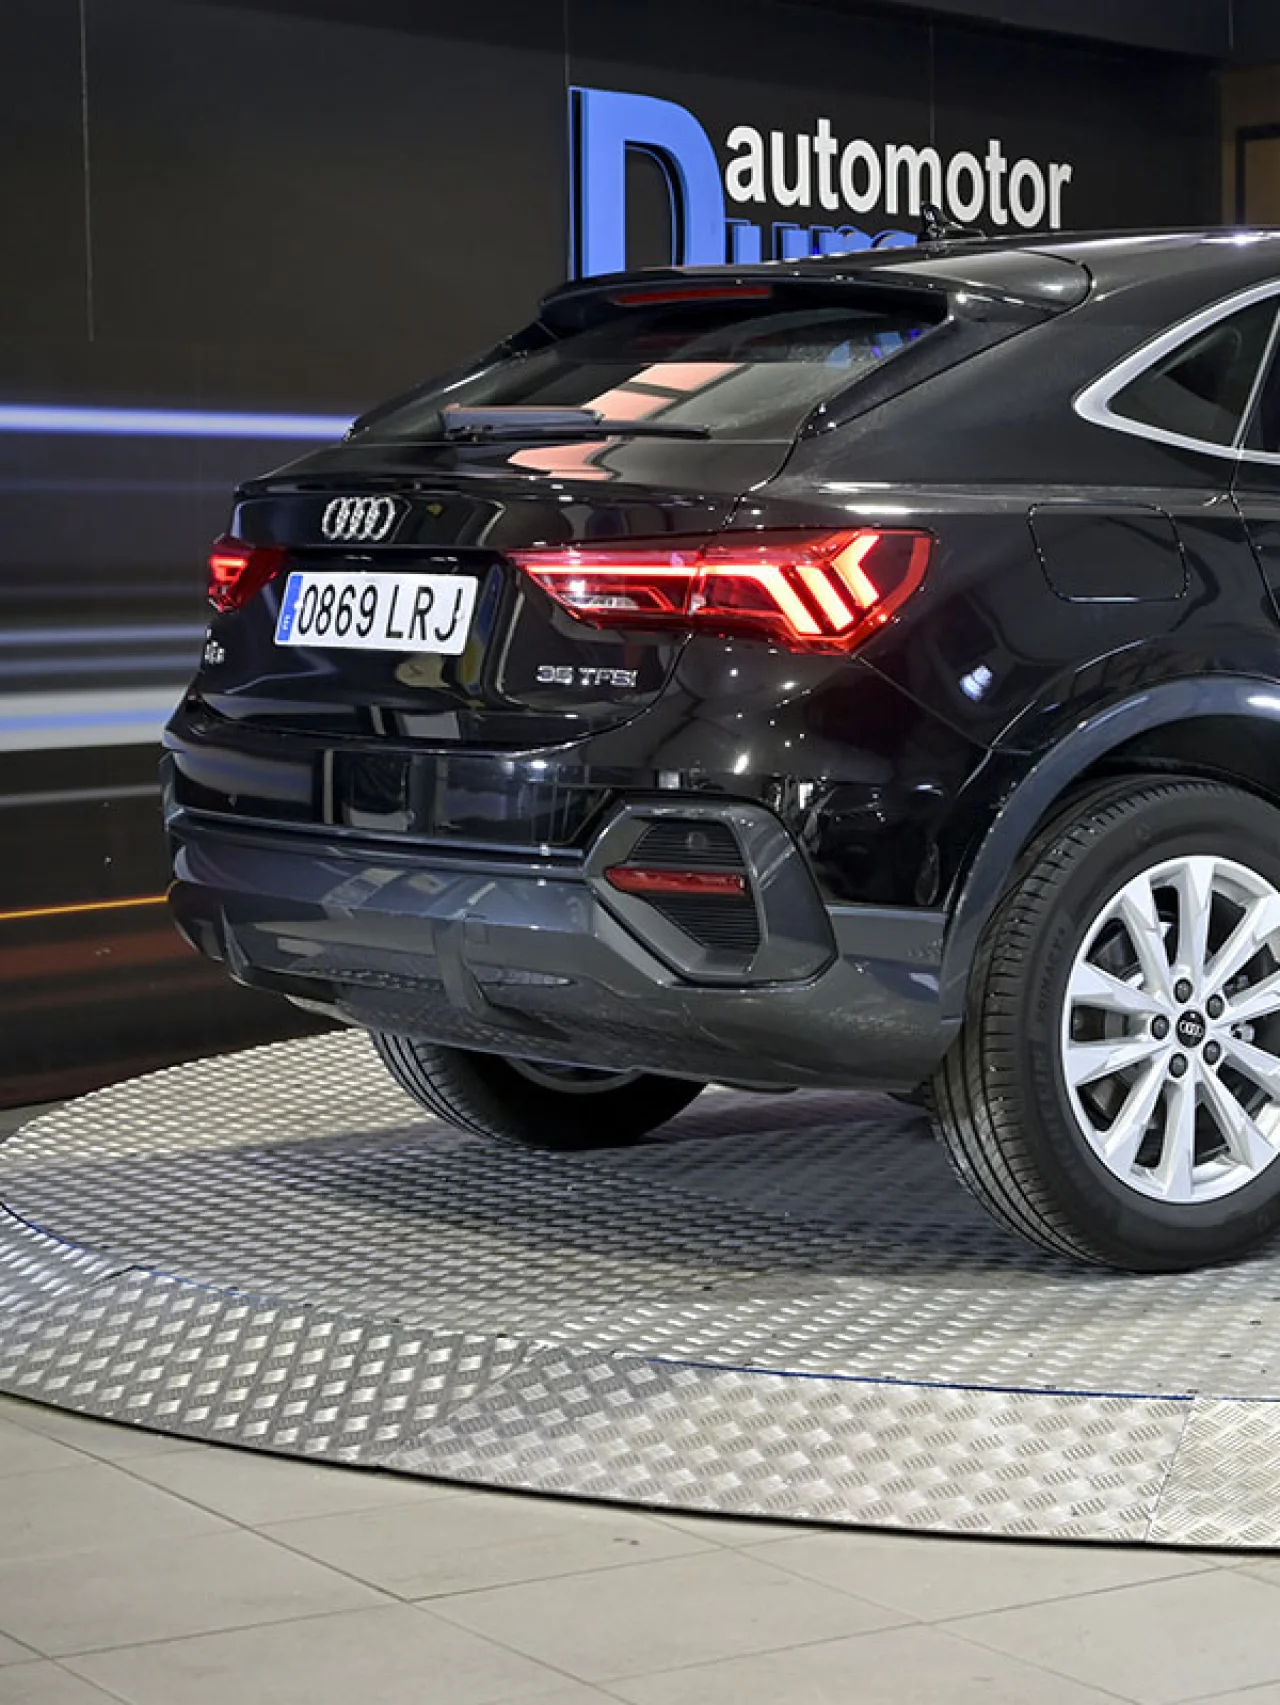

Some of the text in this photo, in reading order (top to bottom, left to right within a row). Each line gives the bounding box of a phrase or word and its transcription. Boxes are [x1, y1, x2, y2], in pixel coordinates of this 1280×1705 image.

[725, 118, 1073, 229] automotor
[298, 584, 463, 642] 0869 LRJ
[578, 667, 638, 688] TFSI
